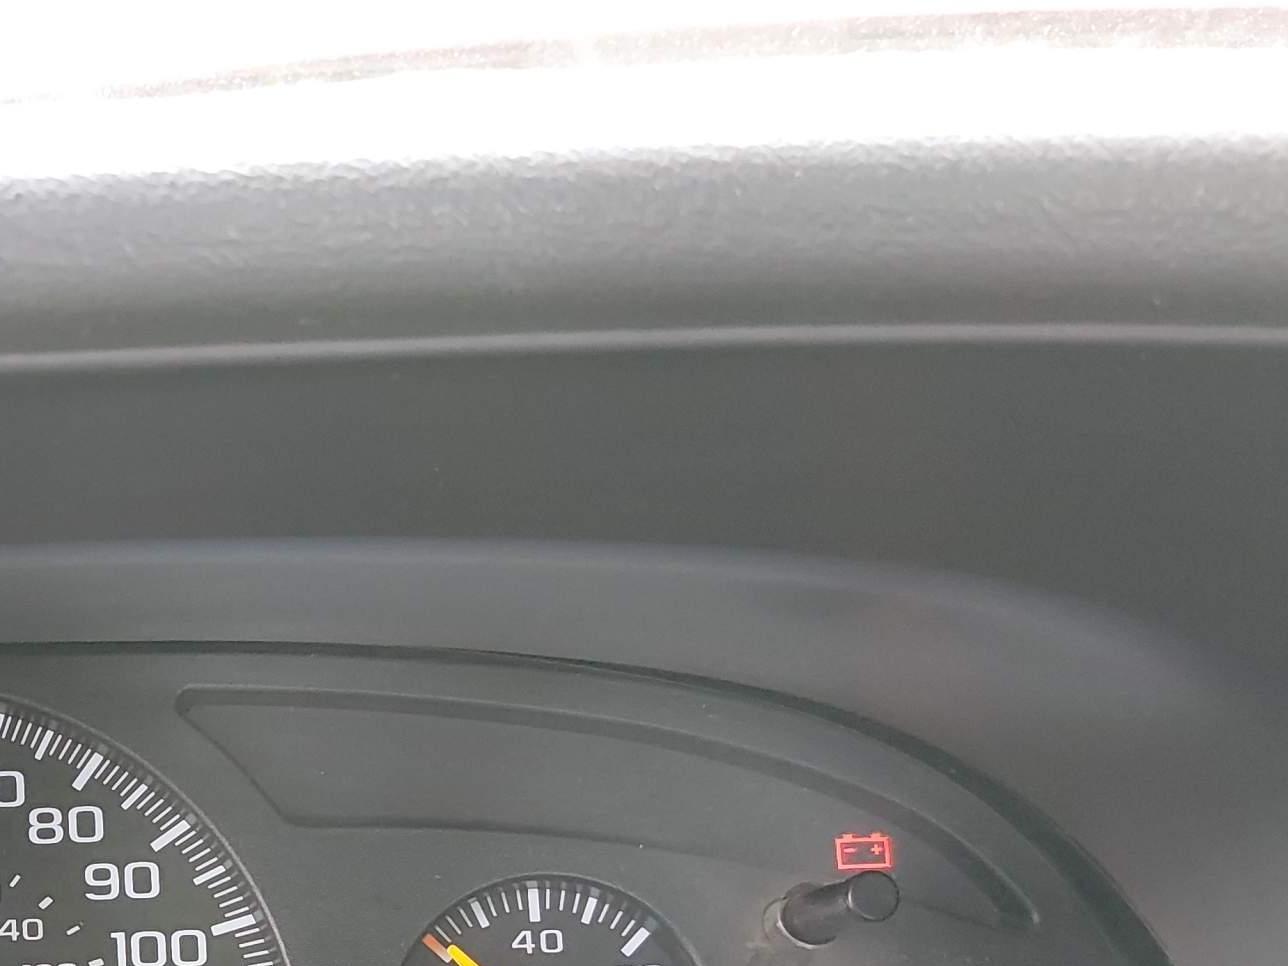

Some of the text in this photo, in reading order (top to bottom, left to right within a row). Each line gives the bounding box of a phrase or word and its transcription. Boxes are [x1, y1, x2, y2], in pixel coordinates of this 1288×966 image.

[28, 805, 104, 845] 80
[84, 861, 160, 901] 90
[511, 929, 564, 954] 40
